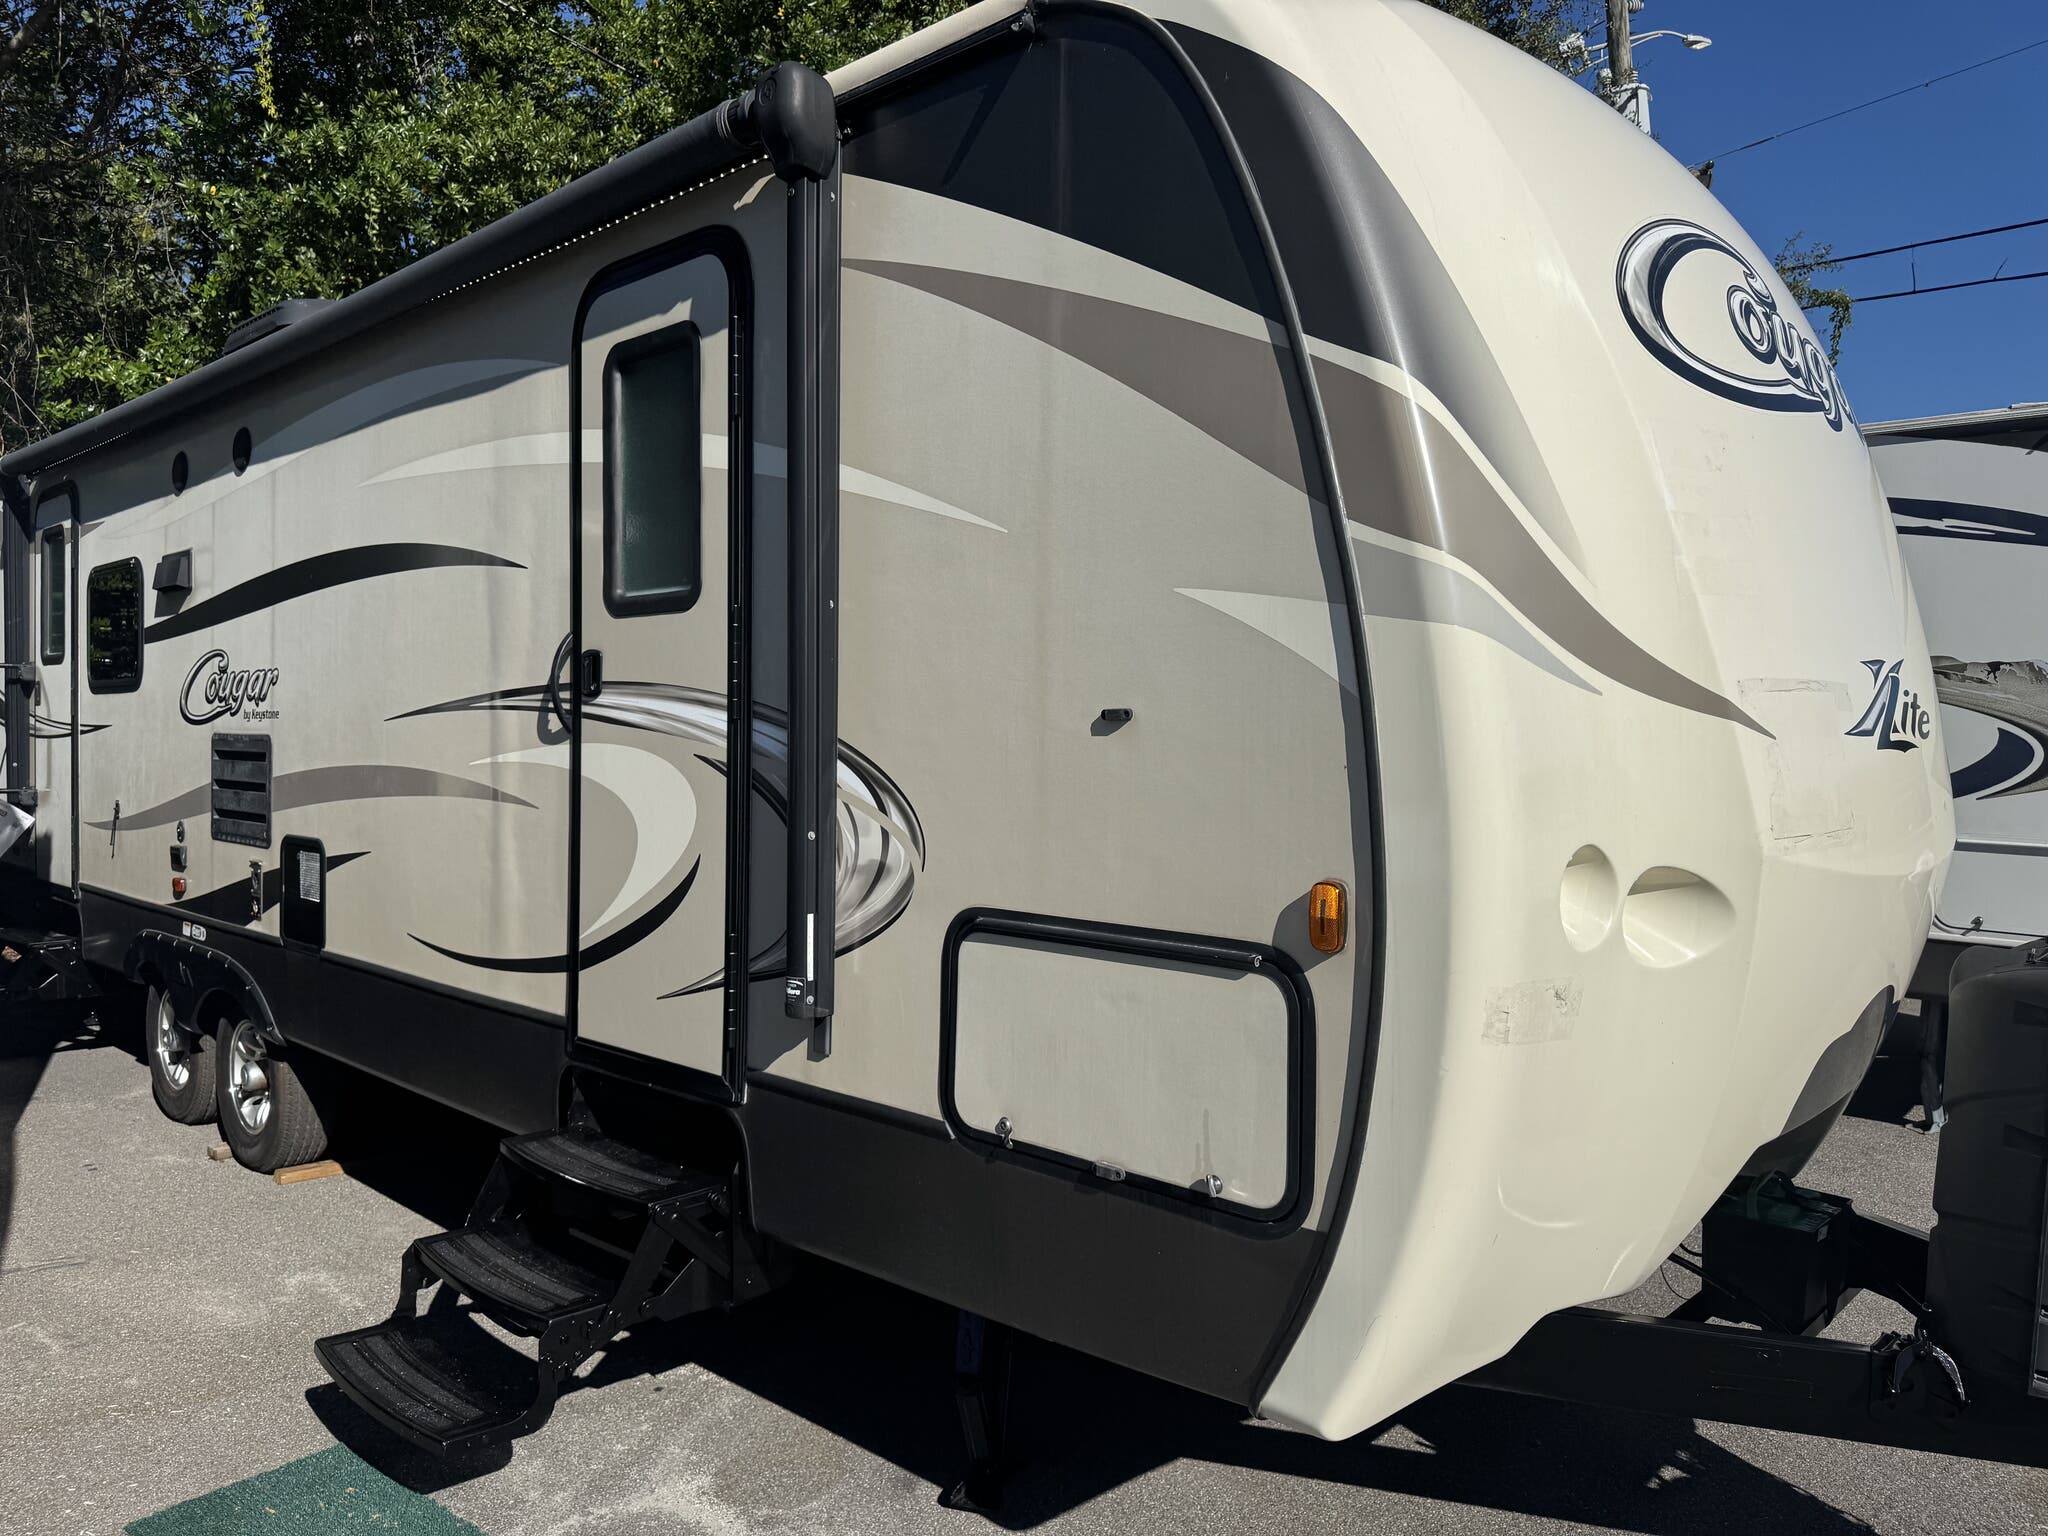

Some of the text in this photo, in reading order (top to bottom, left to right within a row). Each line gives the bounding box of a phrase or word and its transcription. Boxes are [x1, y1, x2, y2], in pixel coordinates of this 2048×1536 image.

[179, 648, 280, 726] Cougar
[243, 709, 280, 722] by Keystone
